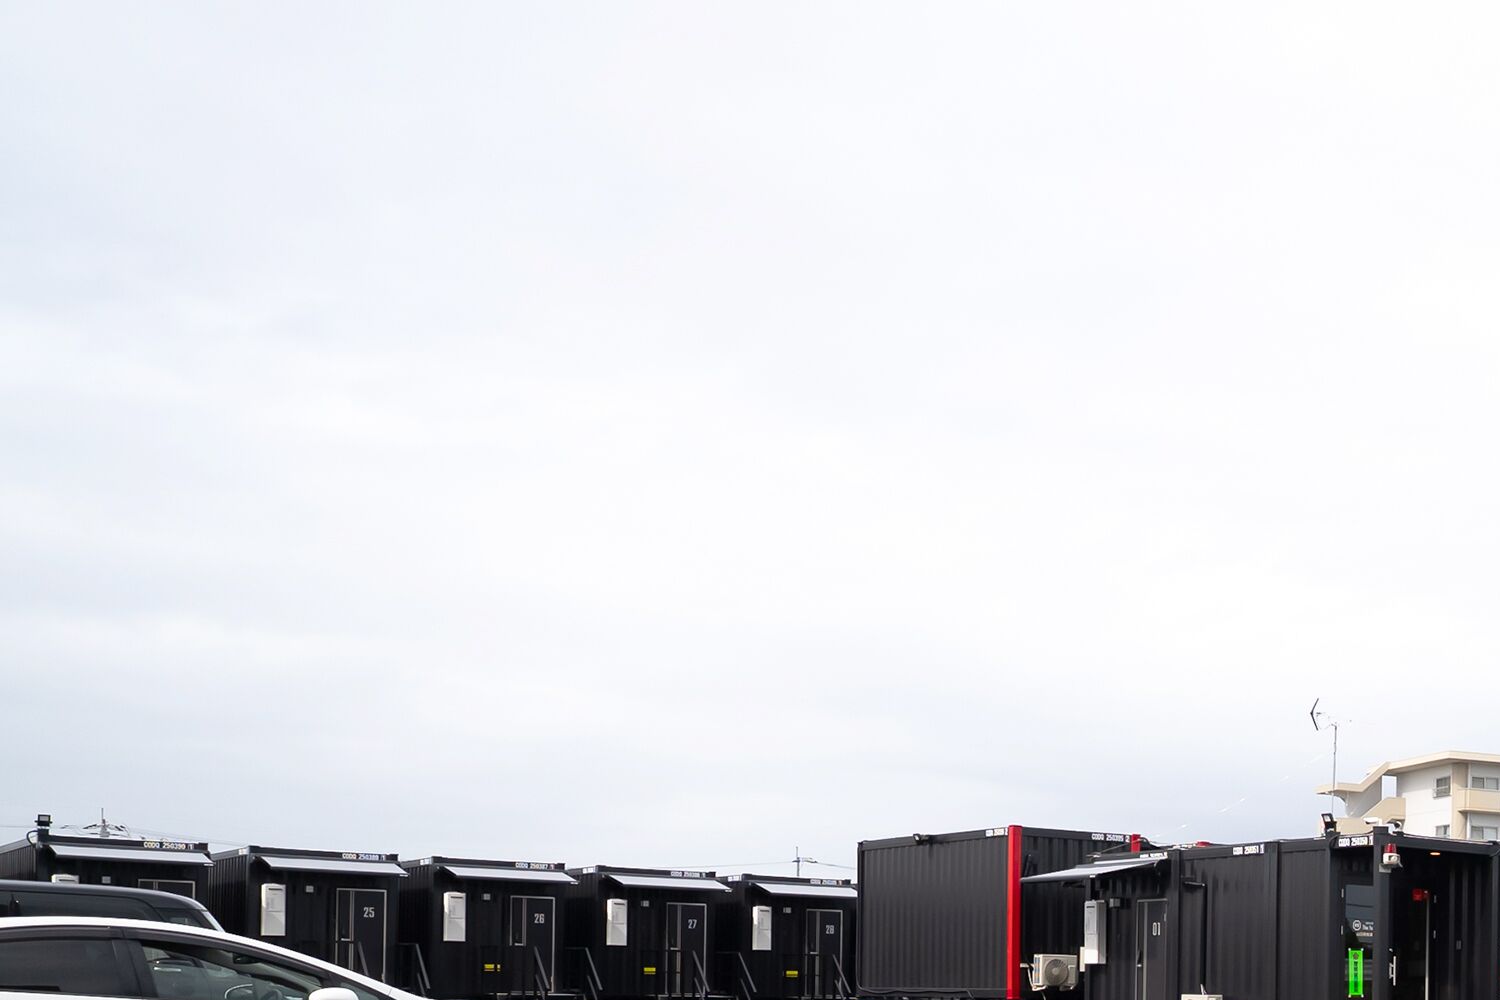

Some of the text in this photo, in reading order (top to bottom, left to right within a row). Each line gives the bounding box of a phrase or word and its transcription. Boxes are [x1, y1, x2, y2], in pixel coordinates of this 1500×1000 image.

[363, 907, 375, 918] 25
[534, 913, 545, 924] 26
[688, 919, 698, 929] 27
[1152, 922, 1161, 936] 01
